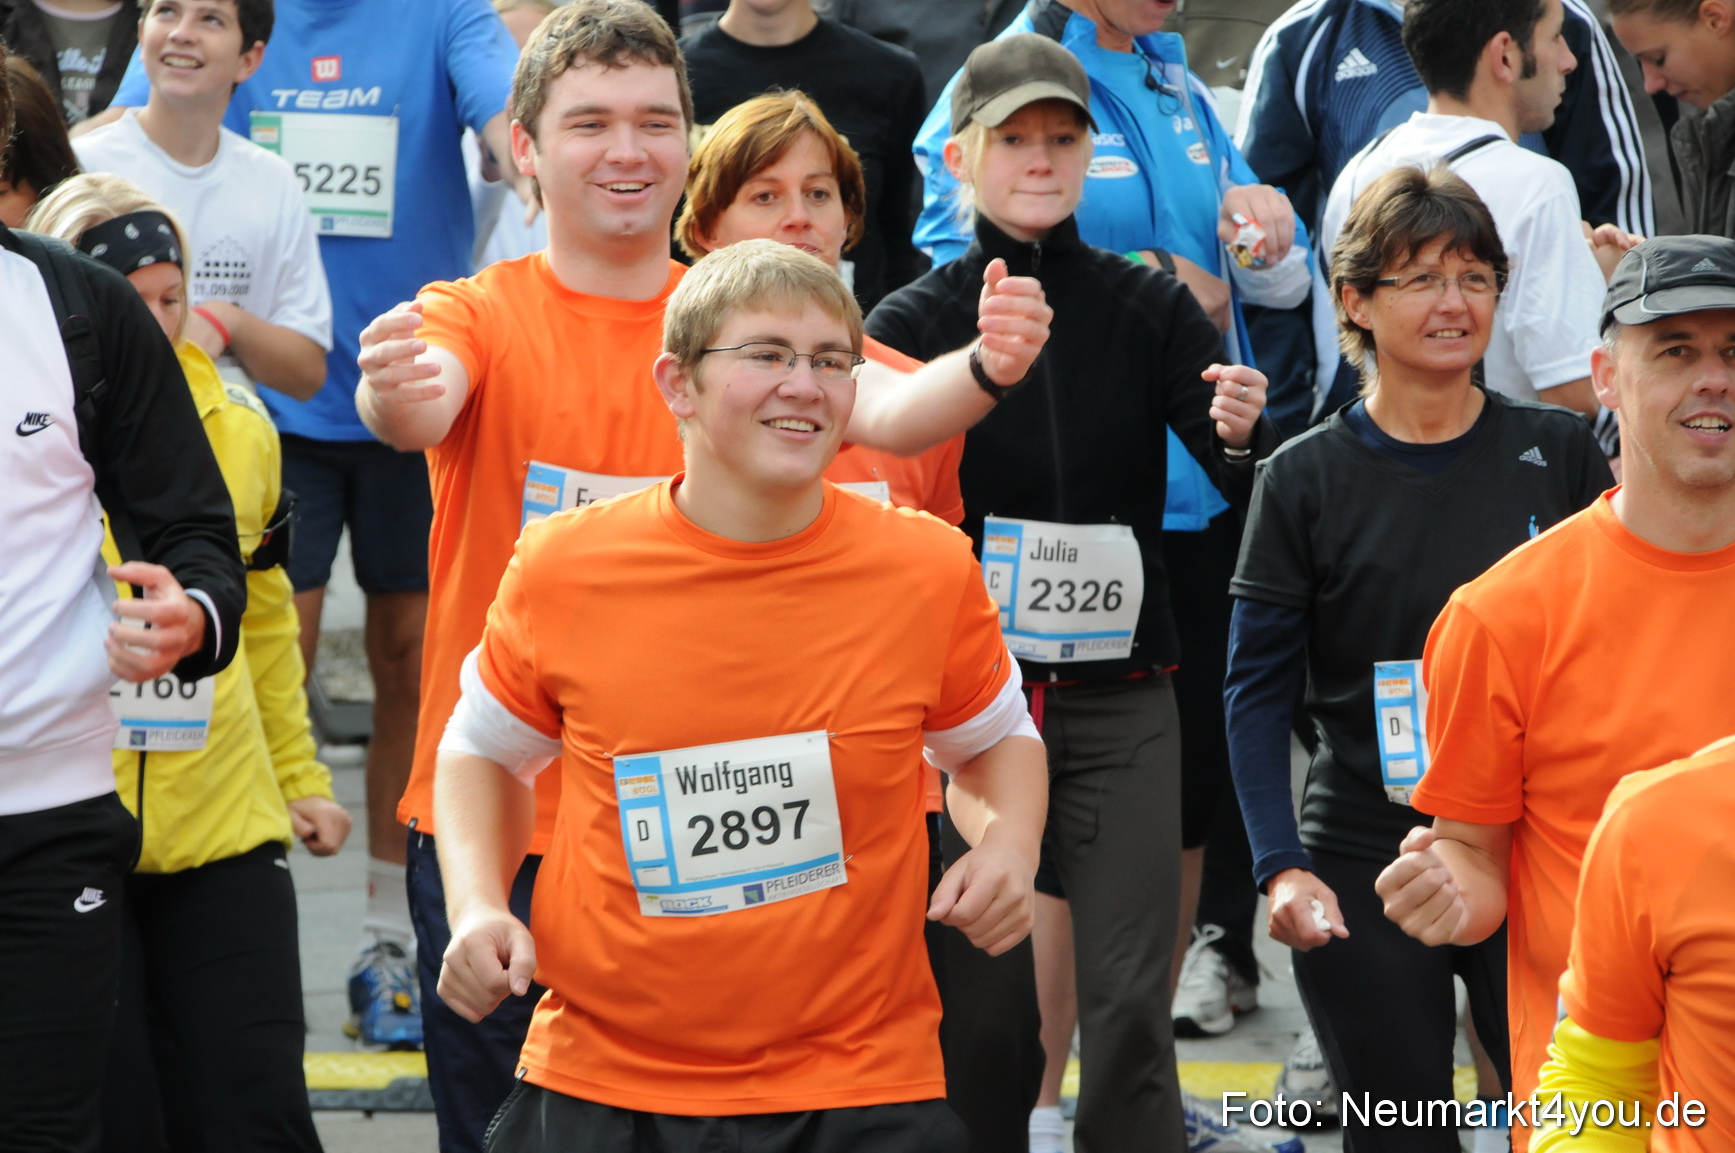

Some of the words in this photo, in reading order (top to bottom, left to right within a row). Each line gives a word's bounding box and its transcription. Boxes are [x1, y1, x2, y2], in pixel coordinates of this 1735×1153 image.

[294, 162, 382, 197] 5225
[24, 411, 51, 426] NIKE
[1030, 537, 1079, 563] Julia
[990, 571, 1000, 590] C
[1028, 577, 1124, 613] 2326
[1390, 717, 1400, 736] D
[675, 760, 794, 796] Wolfgang
[637, 819, 649, 842] D
[687, 798, 811, 858] 2897
[766, 862, 841, 893] PFLEIDERER
